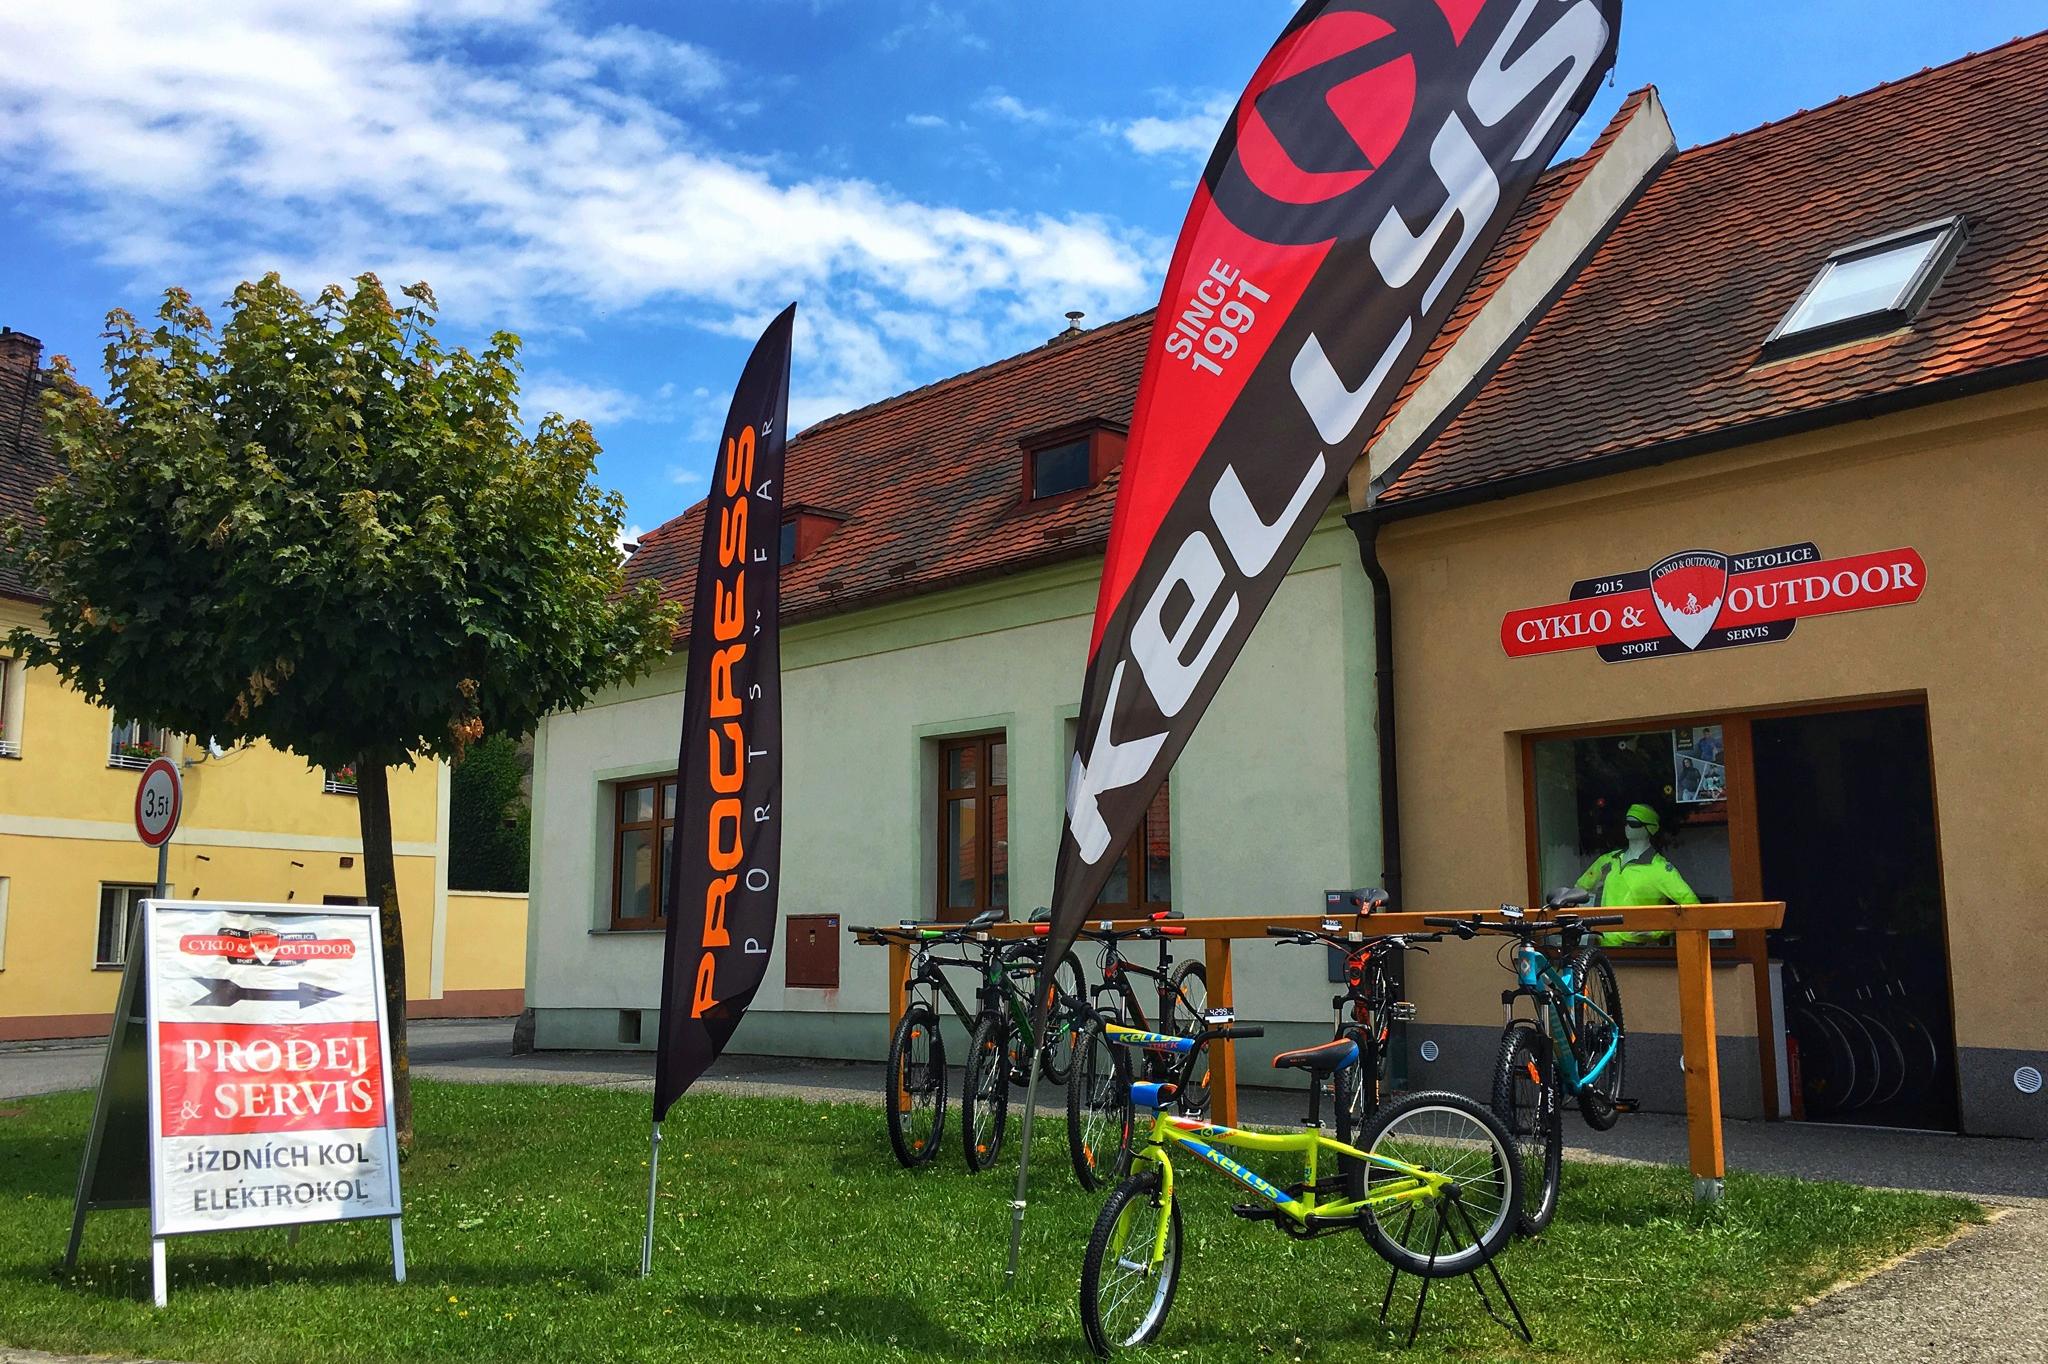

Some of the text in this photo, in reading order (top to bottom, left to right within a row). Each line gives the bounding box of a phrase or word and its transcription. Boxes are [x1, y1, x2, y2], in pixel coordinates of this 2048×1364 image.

[1165, 258, 1240, 360] SINCE
[1192, 279, 1271, 376] 1991
[1656, 556, 1721, 578] CYKLO & OUTDOOR
[1734, 548, 1813, 572] NETOLICE
[1595, 579, 1624, 594] 2015
[1516, 562, 1918, 643] CYKLO & OUTDOOR
[1621, 640, 1660, 655] SPORT
[1726, 625, 1769, 641] SERVIS
[691, 424, 756, 1018] PROGRESS
[188, 939, 354, 955] CYKLO & OUTDOOR
[182, 1037, 368, 1077] PRODEJ
[181, 1079, 374, 1120] & SERVIS
[184, 1142, 369, 1173] JÍZDNÍCH KOL
[194, 1179, 369, 1211] ELEKTROKOL
